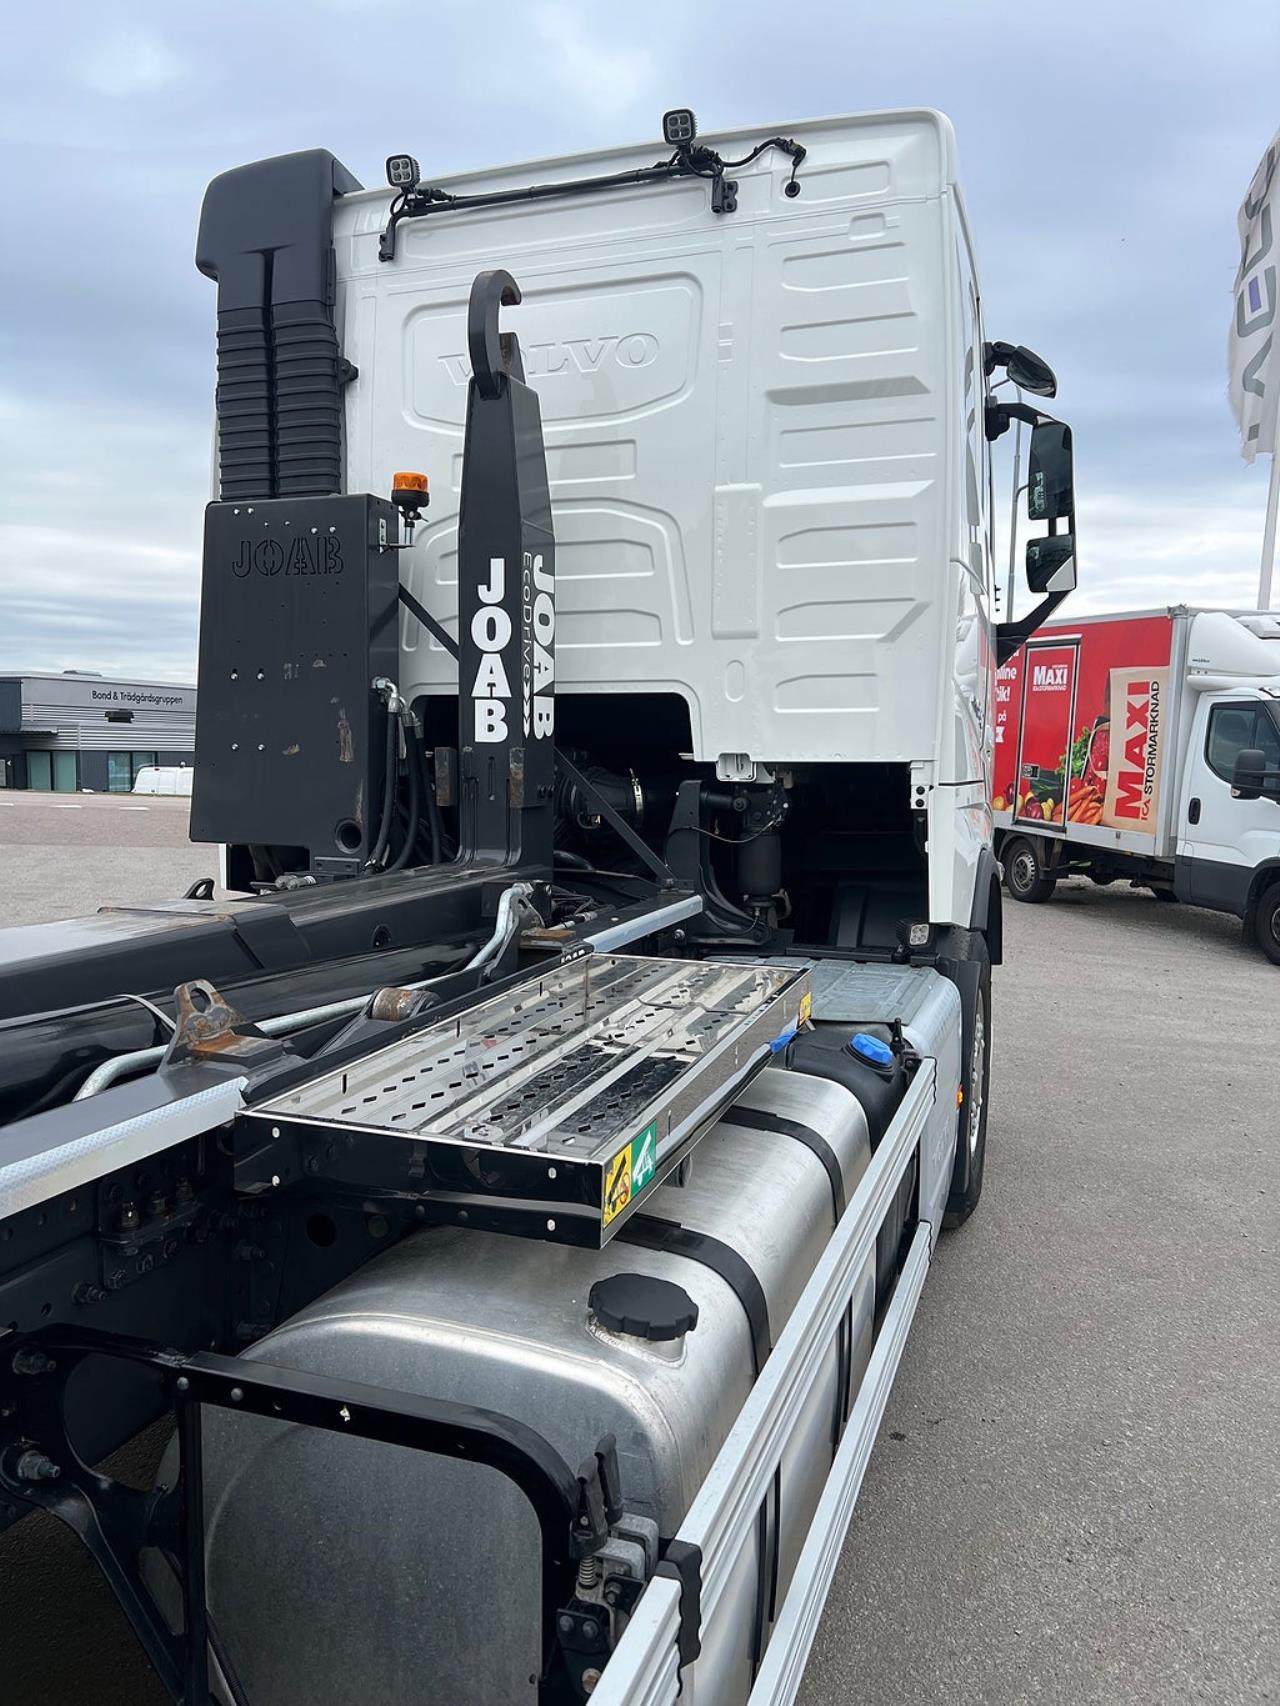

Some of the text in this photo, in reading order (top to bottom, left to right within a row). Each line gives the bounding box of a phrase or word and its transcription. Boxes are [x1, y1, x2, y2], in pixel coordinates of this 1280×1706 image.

[437, 332, 660, 386] VLVO
[232, 535, 344, 578] JOAB
[471, 558, 512, 743] JOAB
[533, 554, 555, 740] JOAB
[1034, 666, 1067, 685] MAXI
[1114, 681, 1150, 819] MAXI
[1144, 681, 1160, 796] STORMARKNAD
